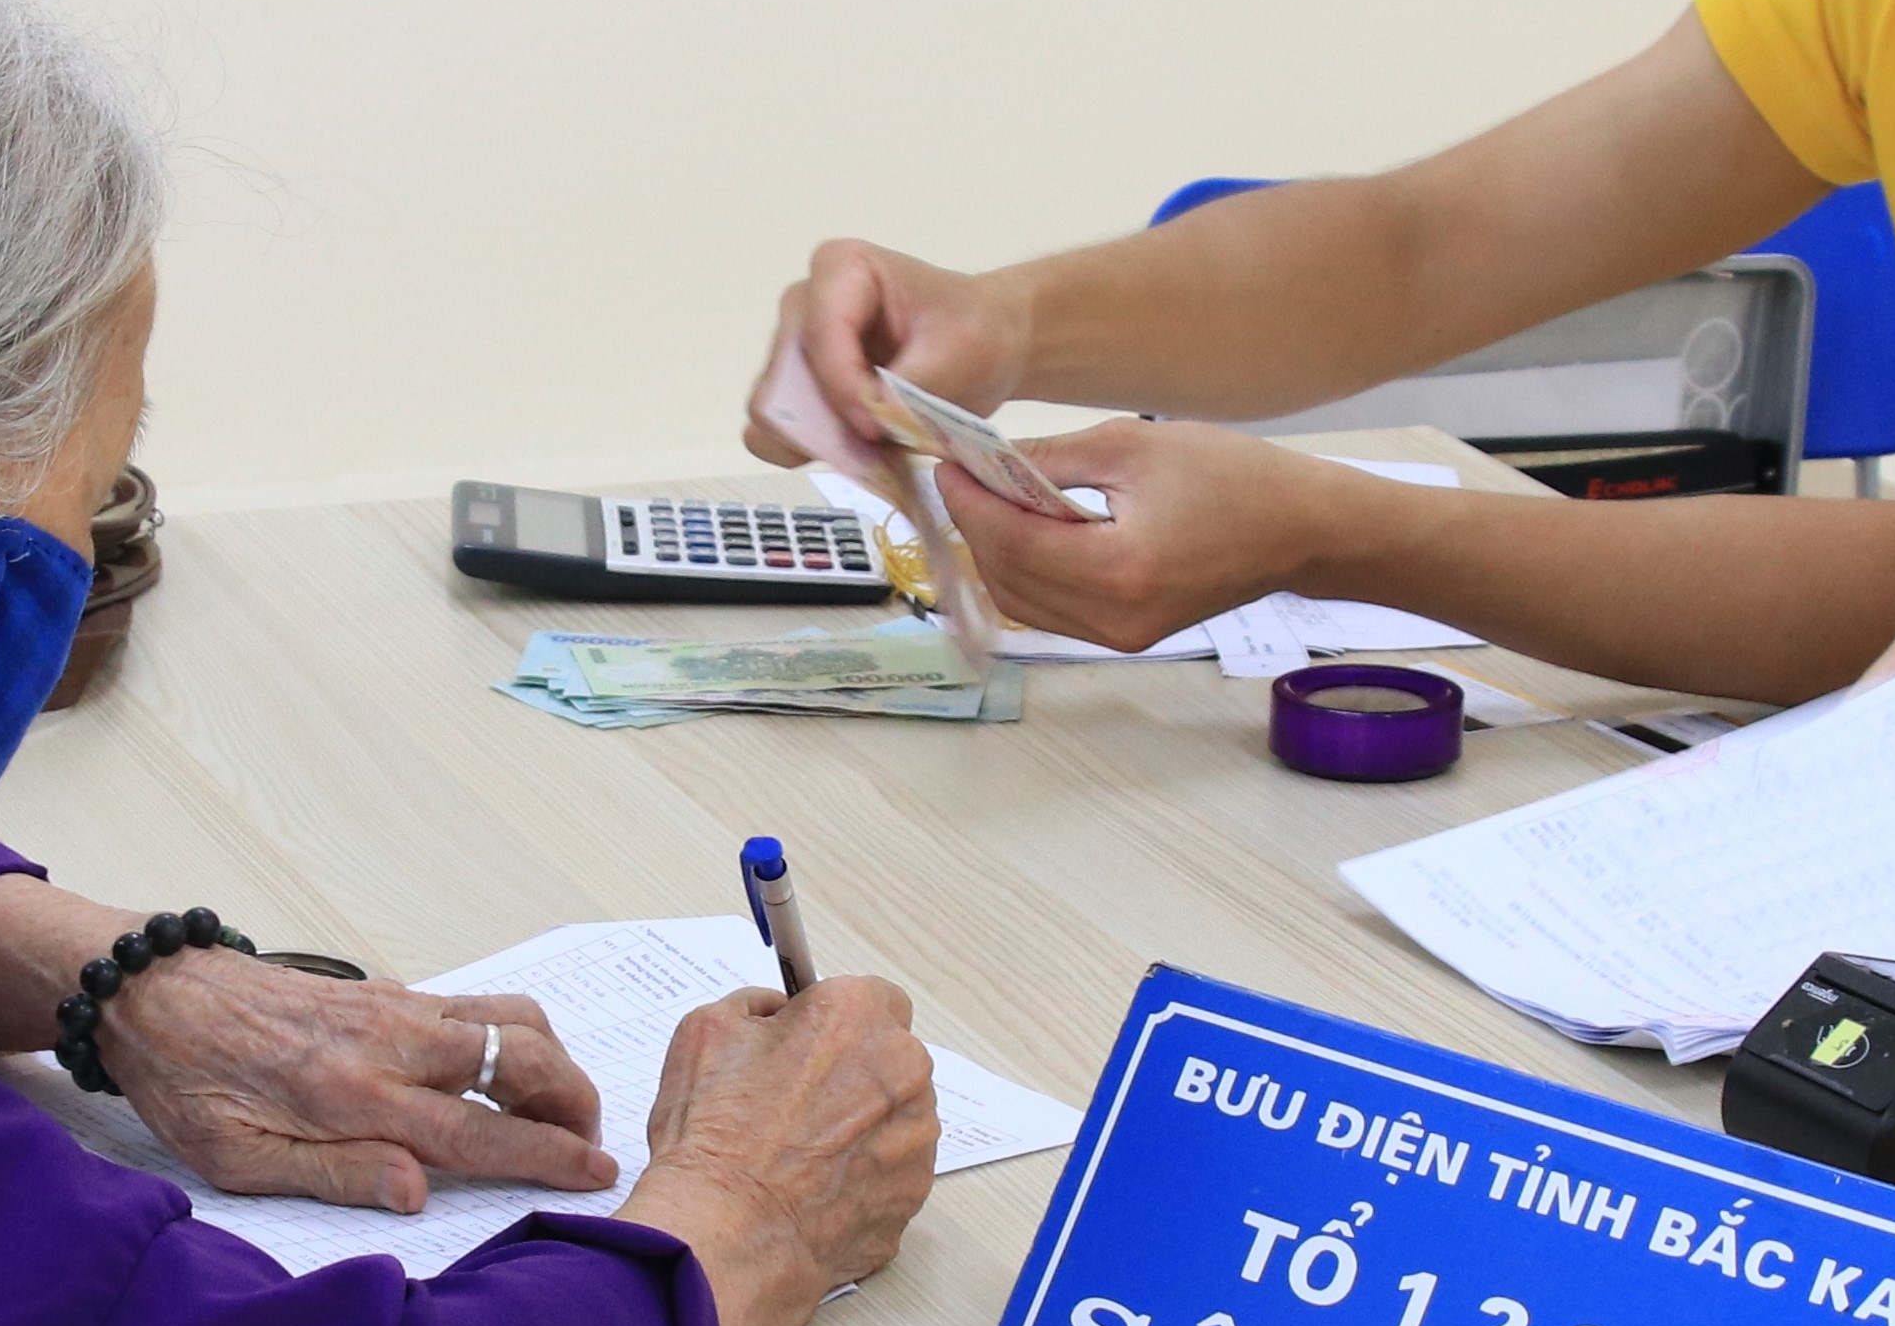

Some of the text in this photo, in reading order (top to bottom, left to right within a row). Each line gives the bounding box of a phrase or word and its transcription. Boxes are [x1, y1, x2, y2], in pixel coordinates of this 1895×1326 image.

[1173, 1056, 1307, 1131] BƯU
[1316, 1101, 1470, 1187] ĐIỆN
[1489, 1143, 1637, 1241] TỈNH
[1648, 1194, 1795, 1290] BẮC
[1241, 1200, 1374, 1307] TỔ
